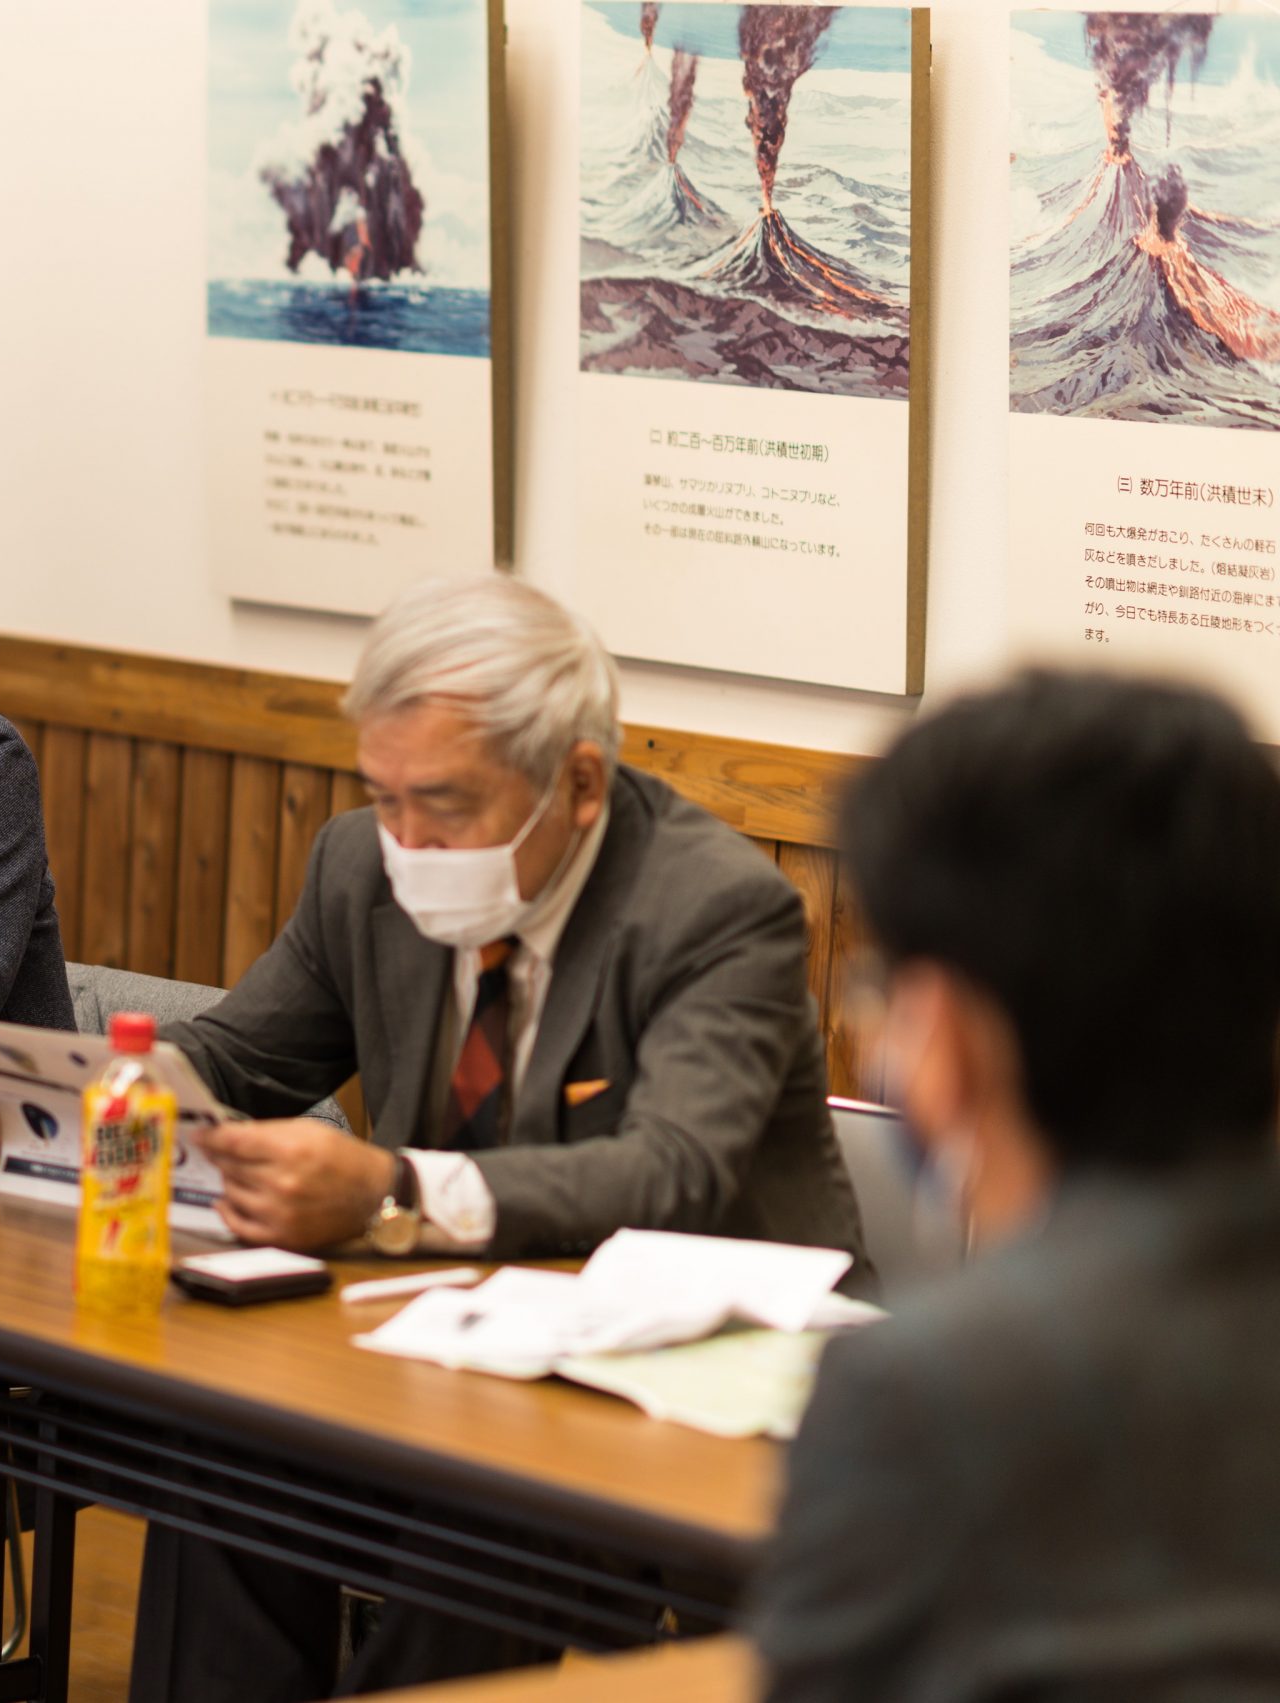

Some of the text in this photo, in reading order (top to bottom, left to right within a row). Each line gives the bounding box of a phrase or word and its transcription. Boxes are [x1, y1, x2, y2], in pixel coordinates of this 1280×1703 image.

[1138, 477, 1274, 508] 数万年前(洪積世末)
[1084, 627, 1110, 643] ます。
